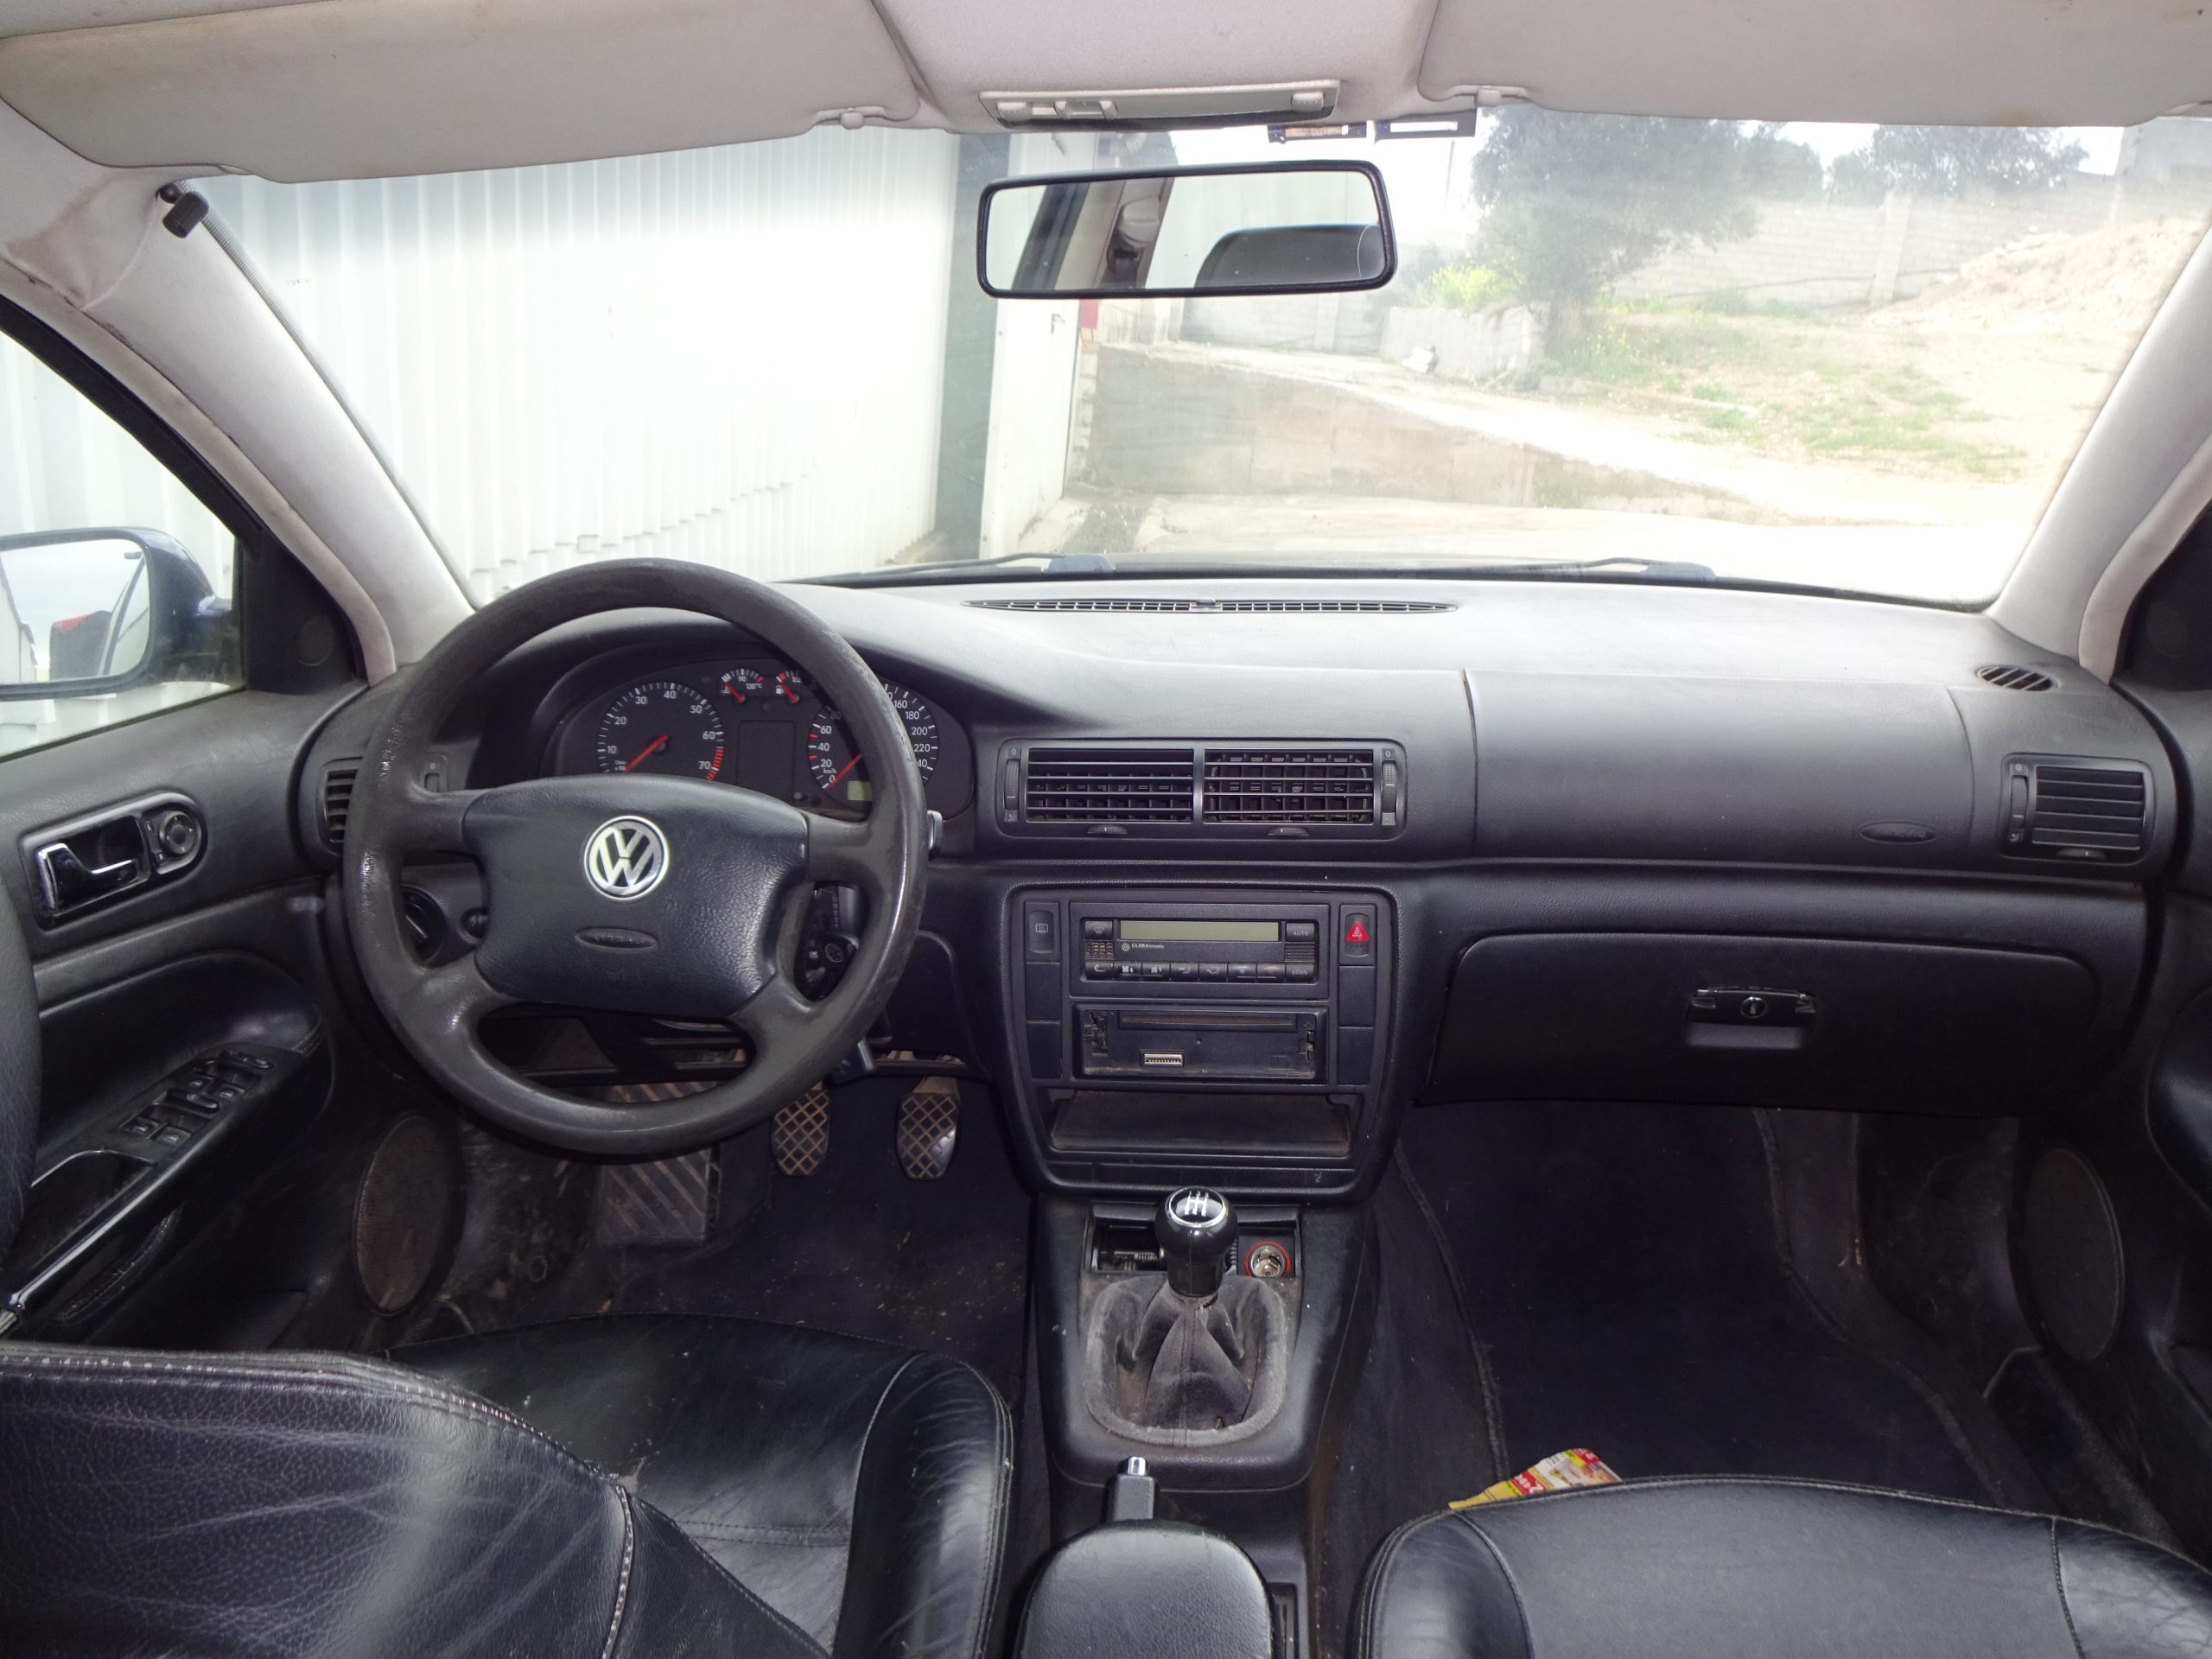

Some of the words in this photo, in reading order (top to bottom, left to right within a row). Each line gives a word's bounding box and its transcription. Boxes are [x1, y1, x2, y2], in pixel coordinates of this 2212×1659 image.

[664, 690, 677, 699] 40
[635, 696, 648, 705] 30
[893, 700, 908, 709] 160
[690, 705, 702, 714] 50
[905, 711, 920, 720] 180
[614, 716, 628, 725] 20
[820, 725, 832, 734] 60
[911, 727, 928, 735] 200
[702, 731, 716, 740] 60
[607, 746, 617, 754] 10
[817, 742, 830, 752] 40
[913, 744, 931, 753] 220
[698, 760, 711, 770] 70
[820, 759, 832, 767] 20
[830, 774, 836, 783] 0
